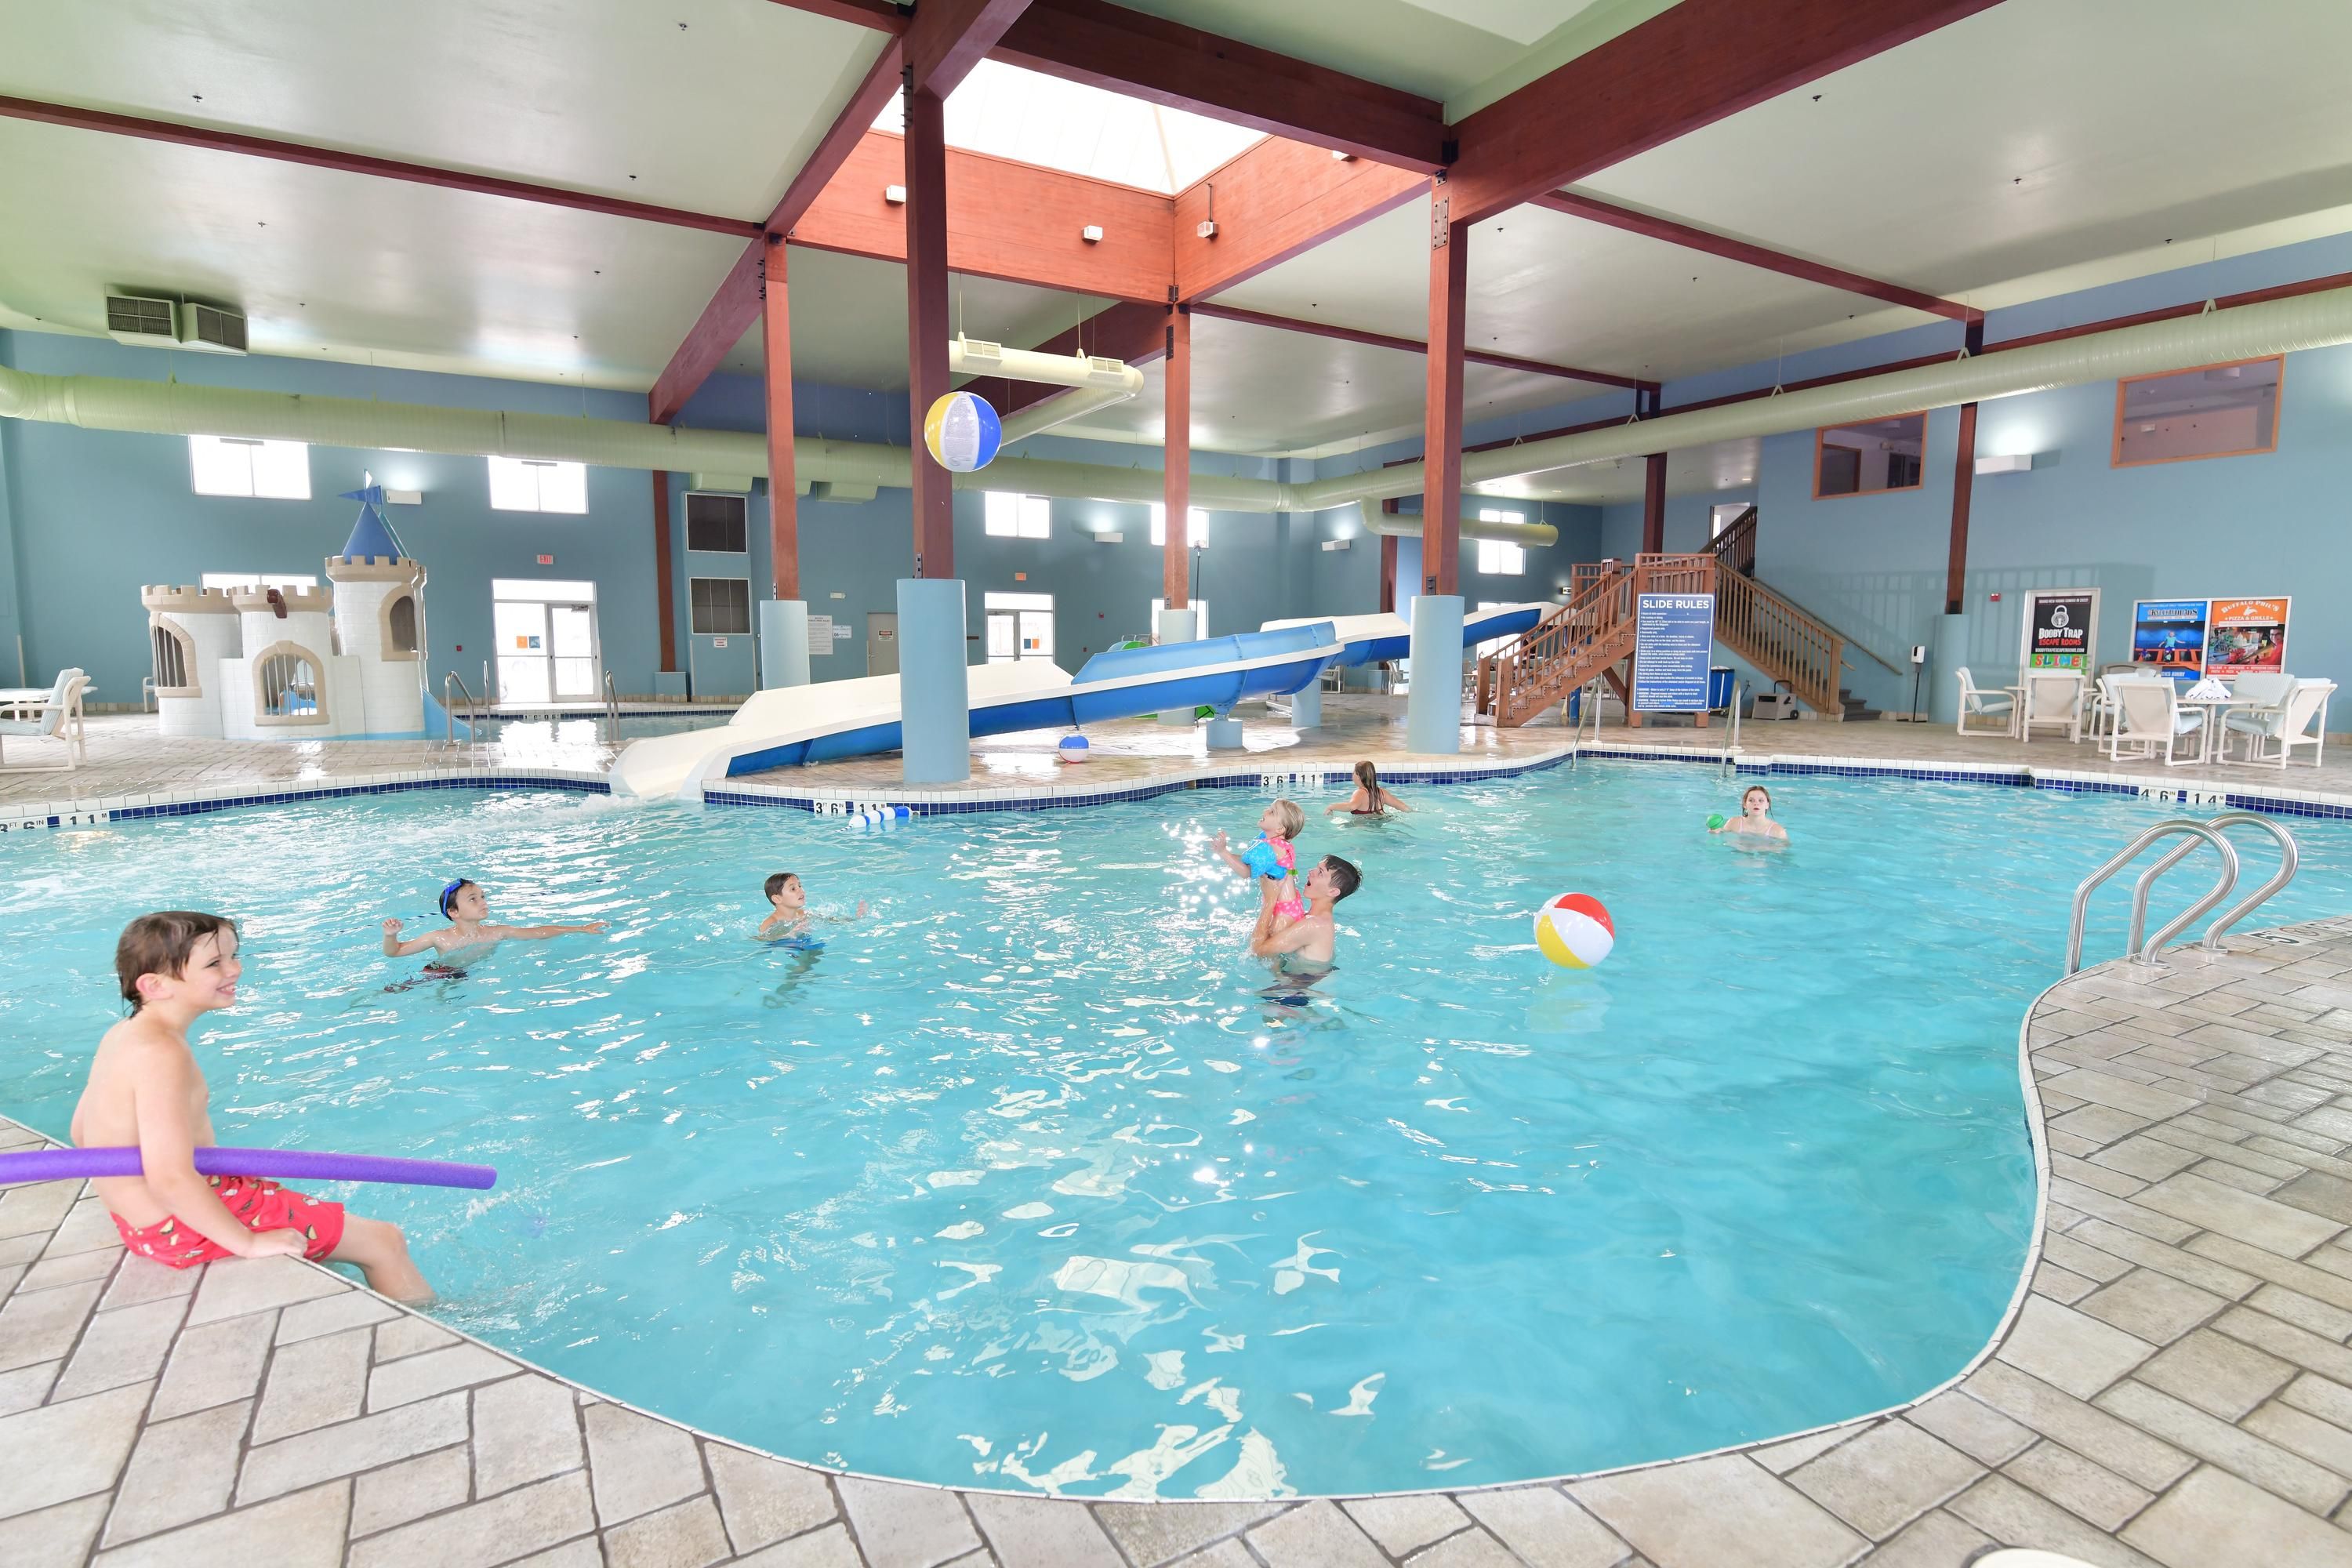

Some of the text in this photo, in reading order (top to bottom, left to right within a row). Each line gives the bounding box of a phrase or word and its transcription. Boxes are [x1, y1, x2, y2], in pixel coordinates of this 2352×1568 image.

[1642, 600, 1709, 609] SLIDE RULES
[2221, 601, 2280, 613] BUFFALO PHIL'S
[2038, 627, 2083, 639] BOOBY TRAP
[815, 802, 823, 813] 3
[831, 803, 839, 813] 6
